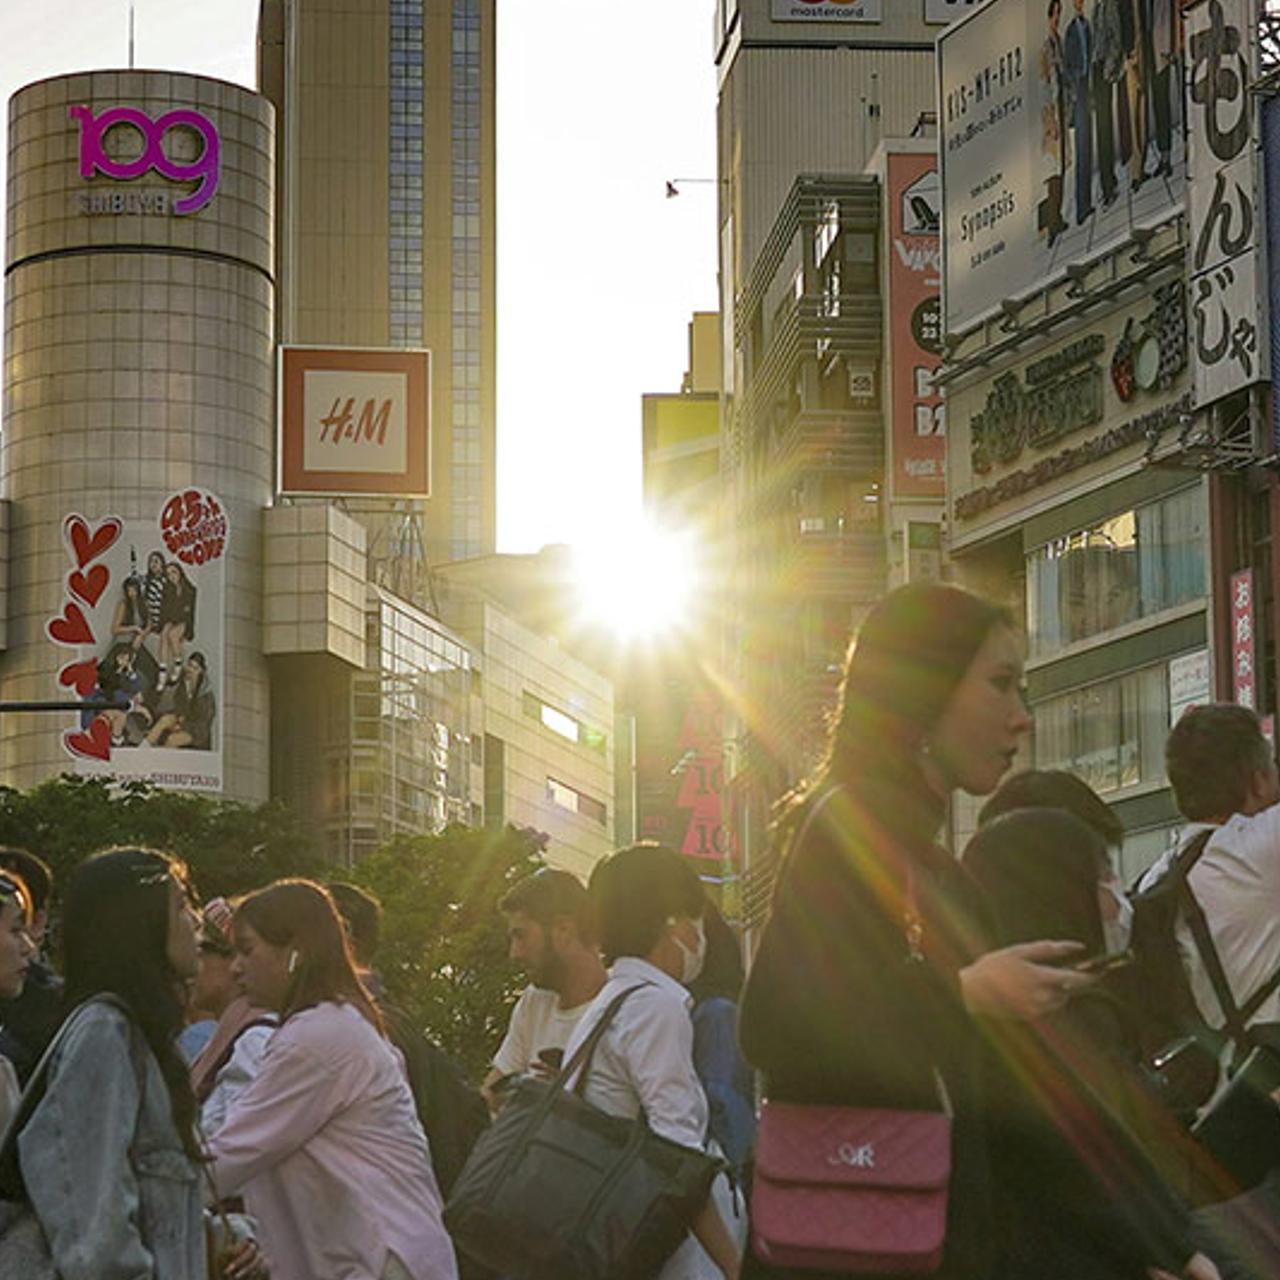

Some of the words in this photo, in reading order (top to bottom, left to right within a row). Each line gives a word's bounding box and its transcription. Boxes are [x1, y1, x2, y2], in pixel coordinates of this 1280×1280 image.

[790, 6, 864, 19] mastercard
[67, 103, 220, 216] 109
[320, 396, 393, 447] H&M
